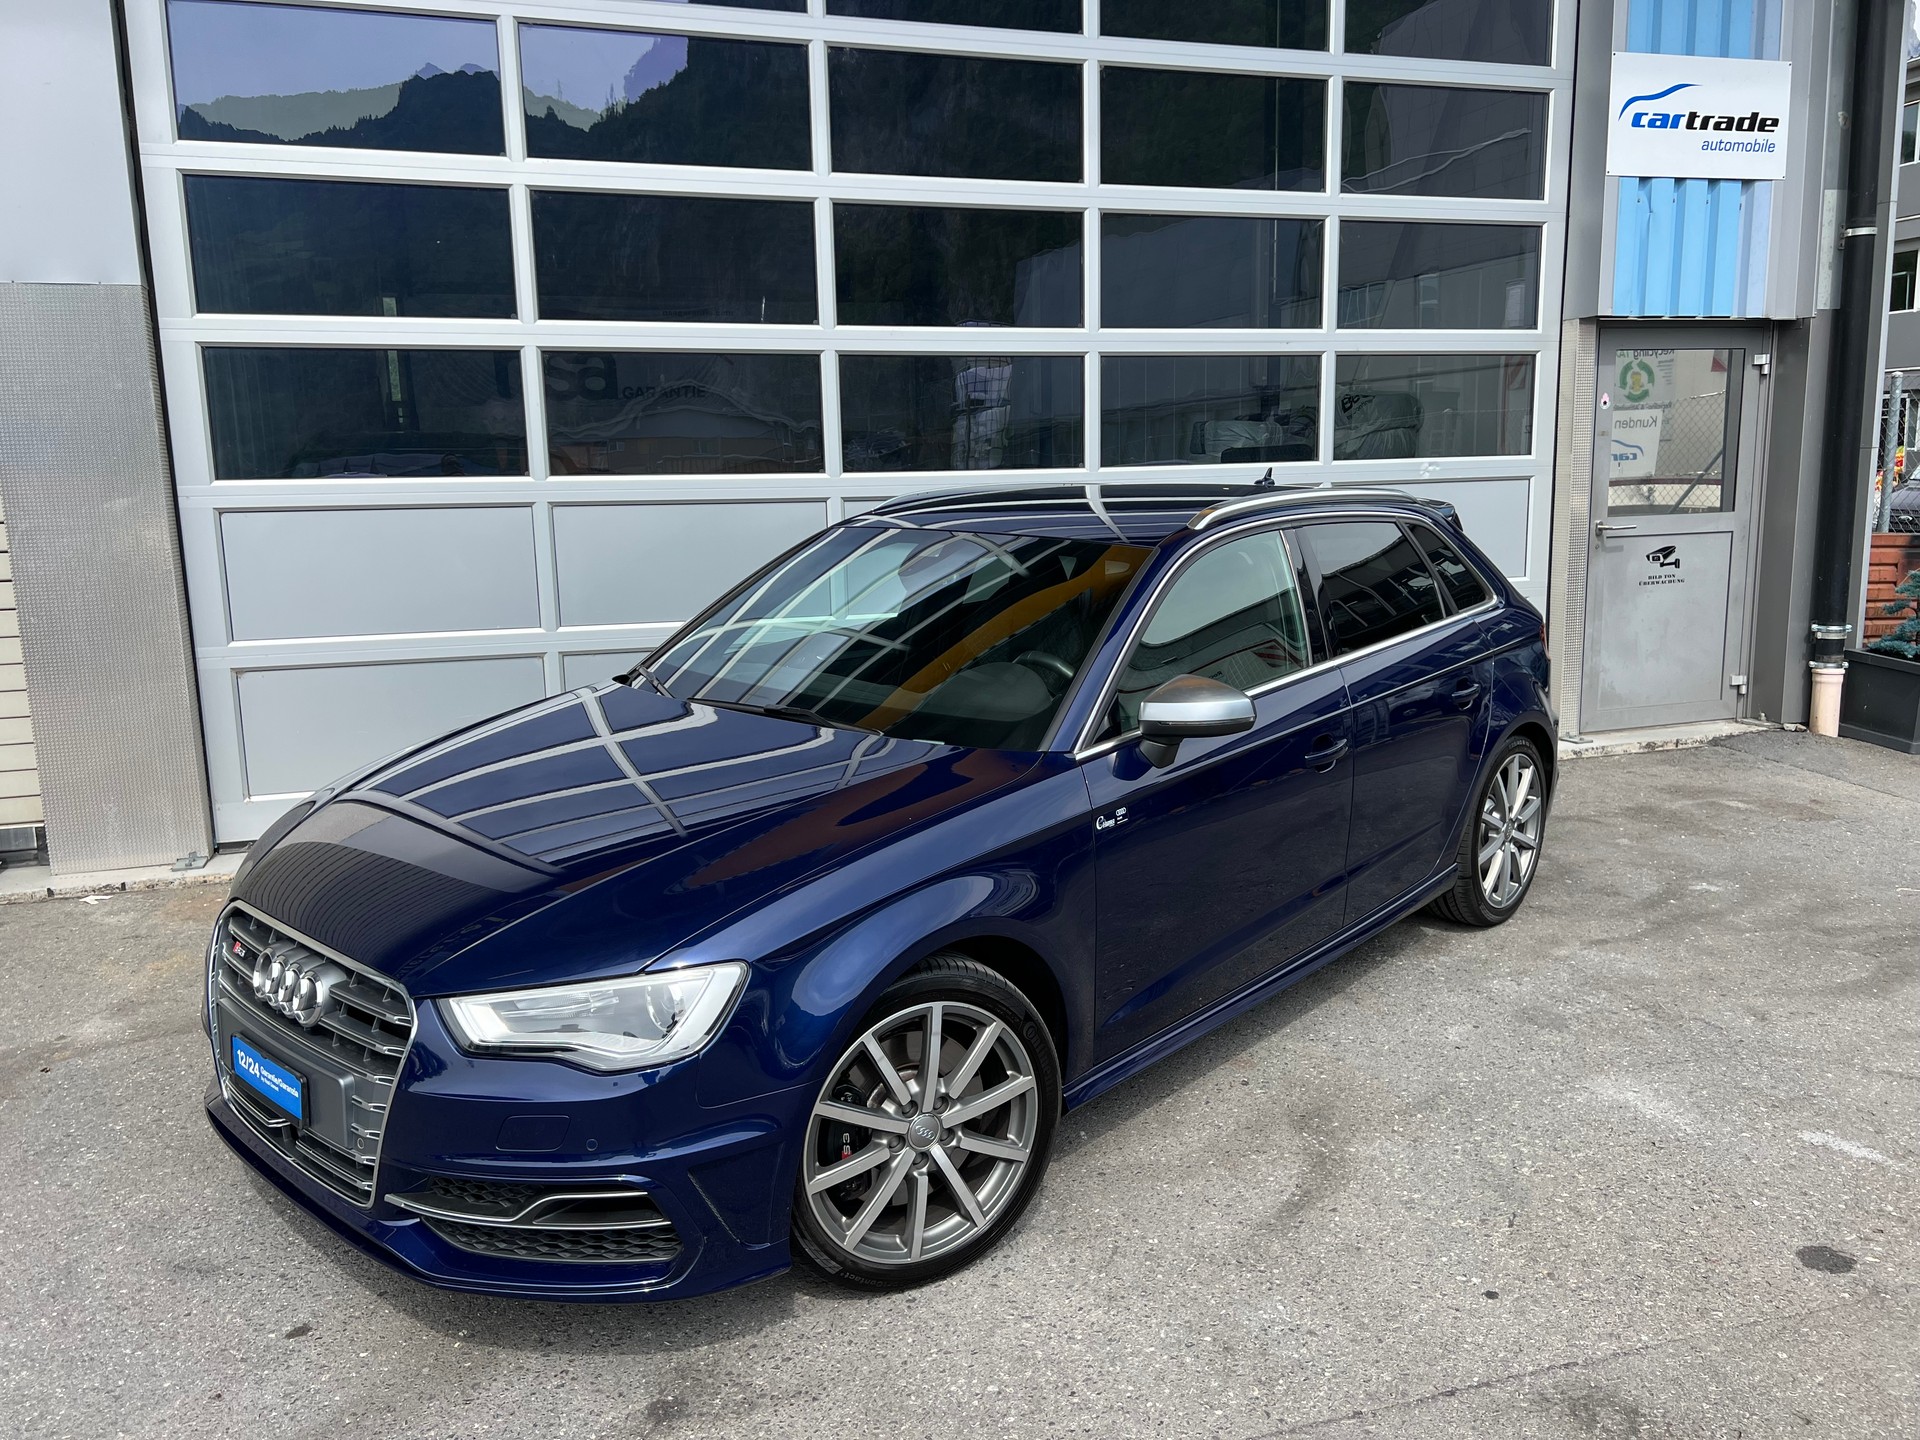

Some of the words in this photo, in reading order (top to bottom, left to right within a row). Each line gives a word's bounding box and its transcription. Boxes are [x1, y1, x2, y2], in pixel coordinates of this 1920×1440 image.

[1631, 111, 1780, 133] cartrade
[1701, 139, 1776, 153] automobile
[237, 1049, 260, 1078] 12/24
[842, 1132, 851, 1156] S3
